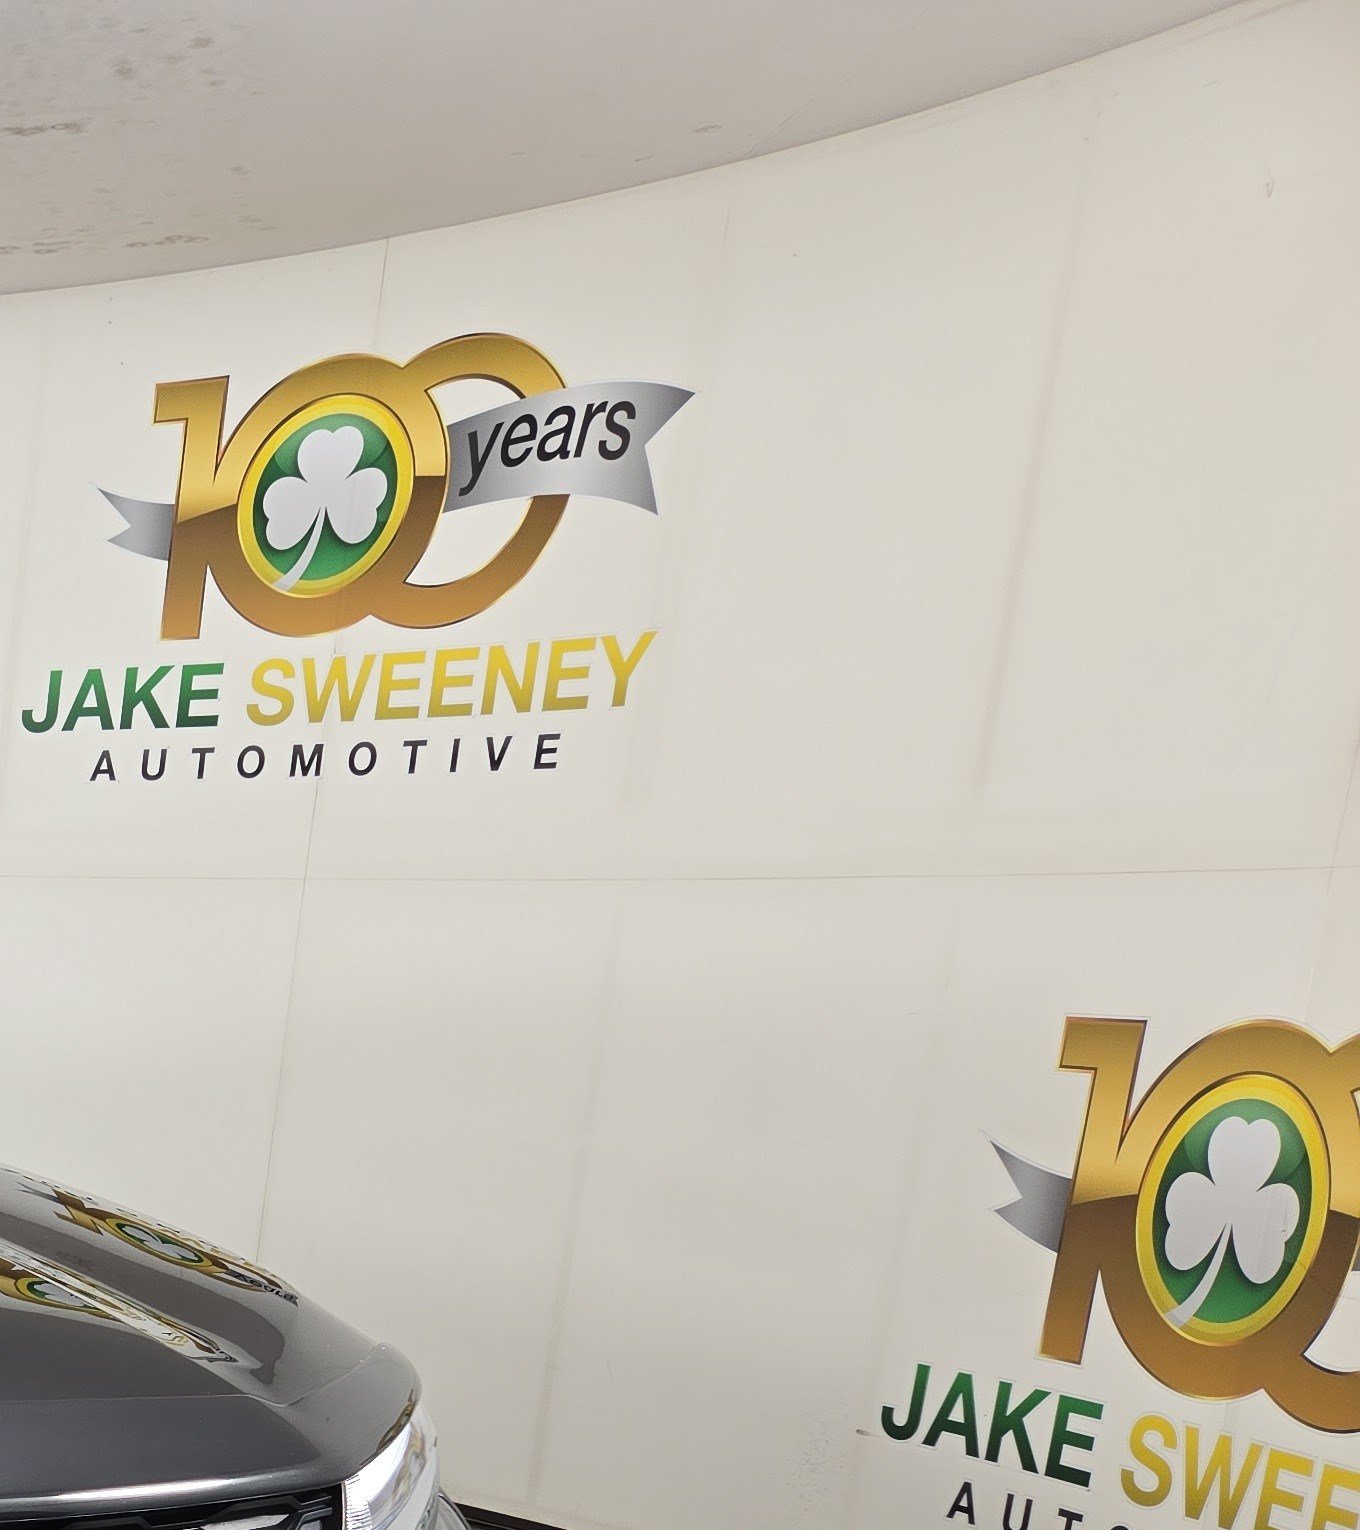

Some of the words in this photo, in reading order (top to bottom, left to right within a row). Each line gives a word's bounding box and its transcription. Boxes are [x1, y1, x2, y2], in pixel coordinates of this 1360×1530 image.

[458, 399, 636, 496] years
[21, 662, 225, 734] JAKE
[245, 631, 658, 727] SWEENEY
[91, 733, 562, 782] AUTOMOTIVE
[881, 1363, 1105, 1489] JAKE
